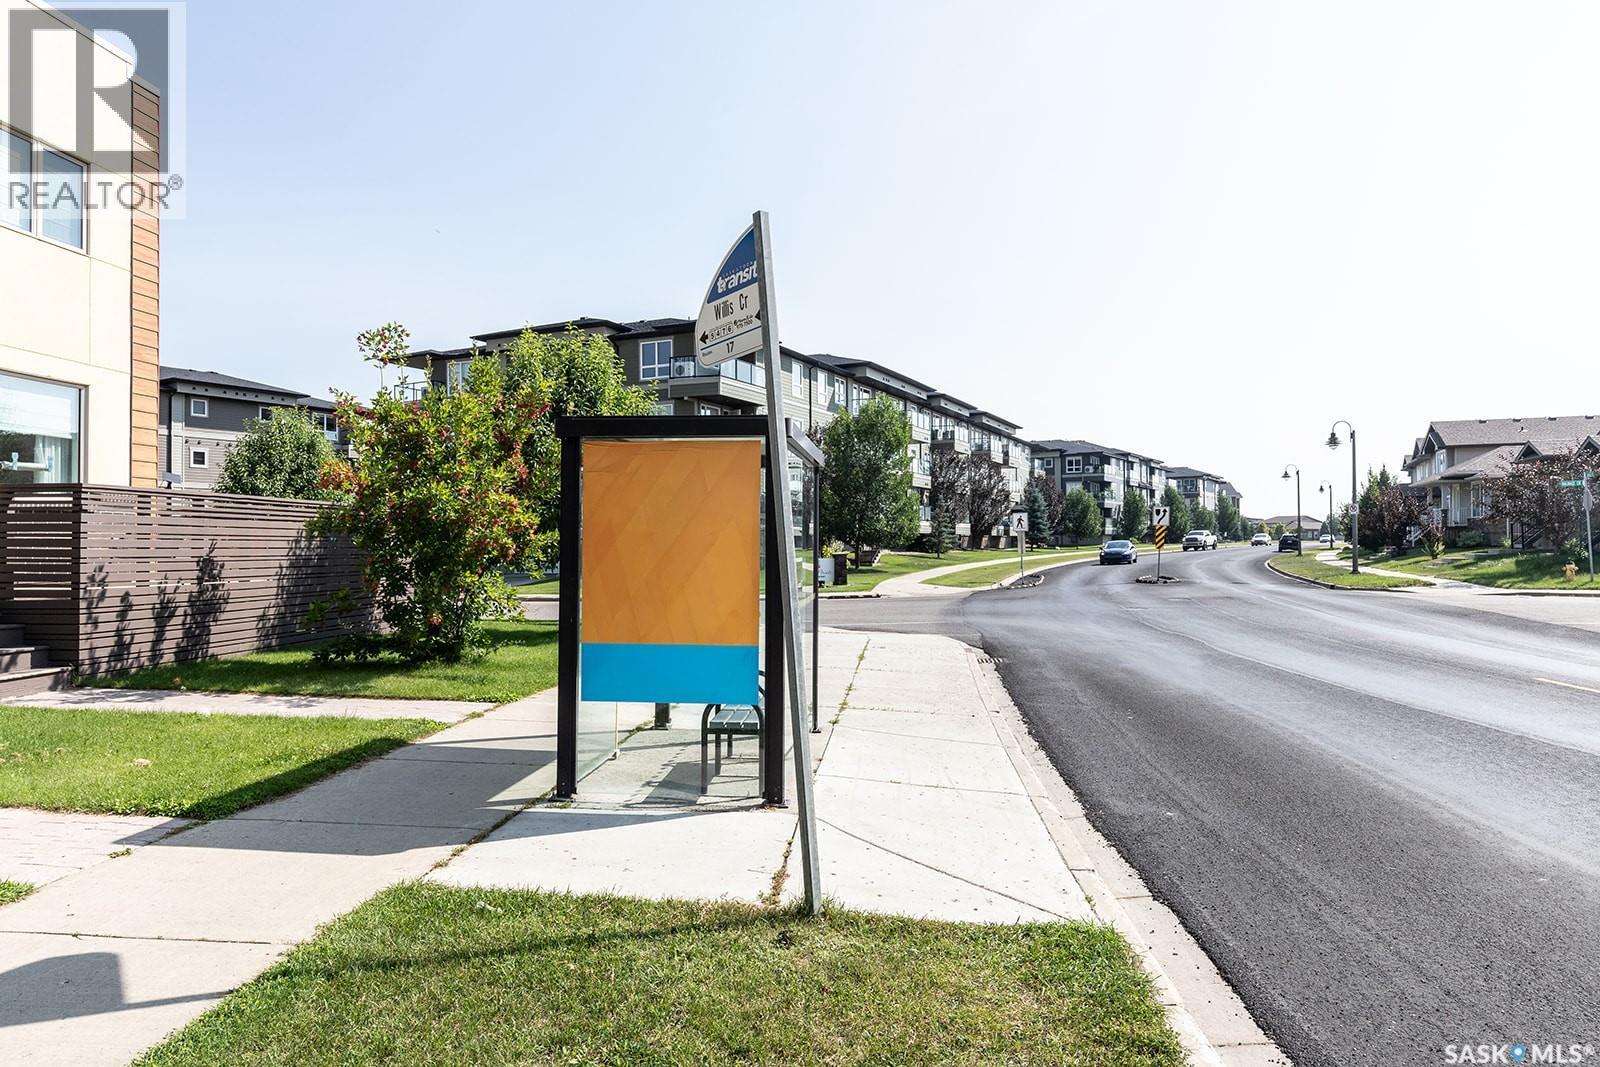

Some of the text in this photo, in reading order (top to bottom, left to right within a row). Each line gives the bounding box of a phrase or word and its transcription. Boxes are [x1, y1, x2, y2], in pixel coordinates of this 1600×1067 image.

[717, 260, 758, 294] transit
[713, 299, 734, 320] Willis
[739, 293, 749, 311] Cr
[726, 341, 735, 354] 17
